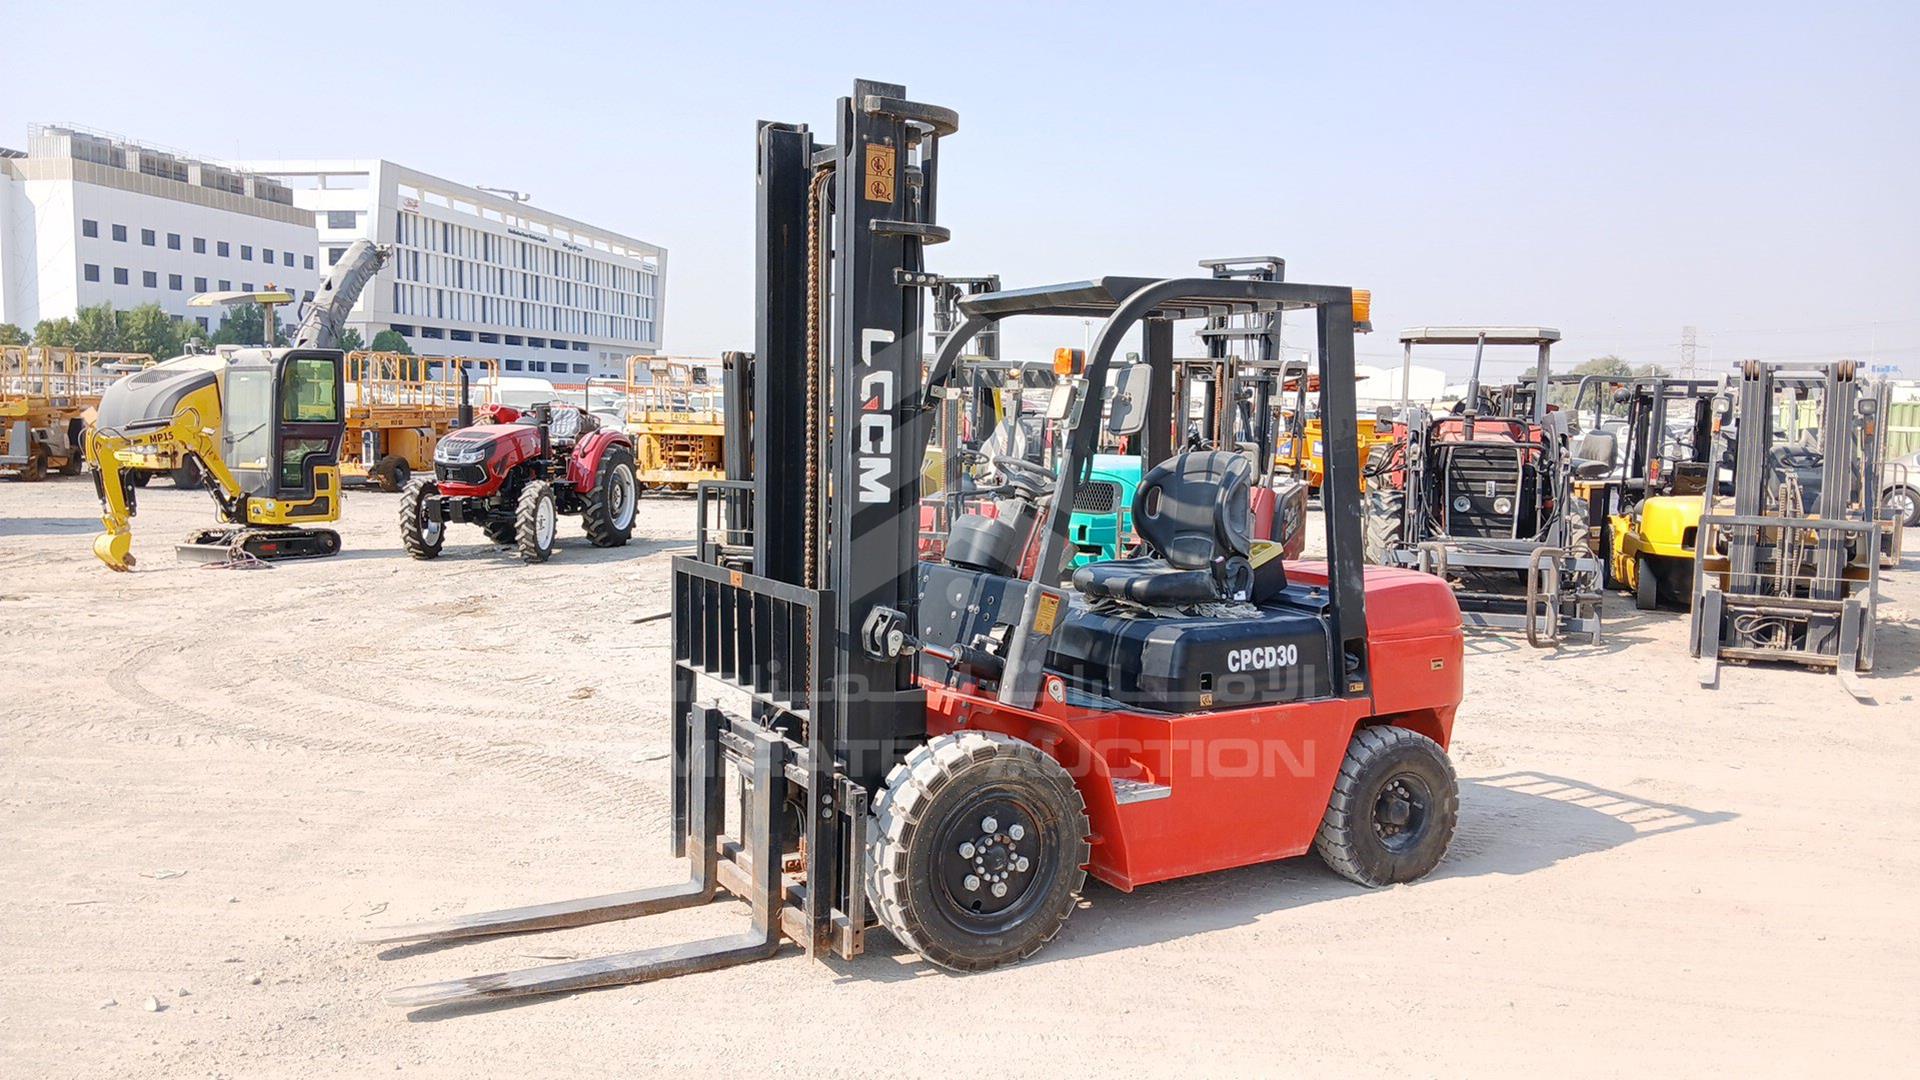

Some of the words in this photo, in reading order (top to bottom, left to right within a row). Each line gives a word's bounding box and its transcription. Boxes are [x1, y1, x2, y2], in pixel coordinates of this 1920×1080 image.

[858, 328, 896, 503] LGCM
[149, 431, 174, 443] MP15
[1227, 644, 1298, 673] CPCD30
